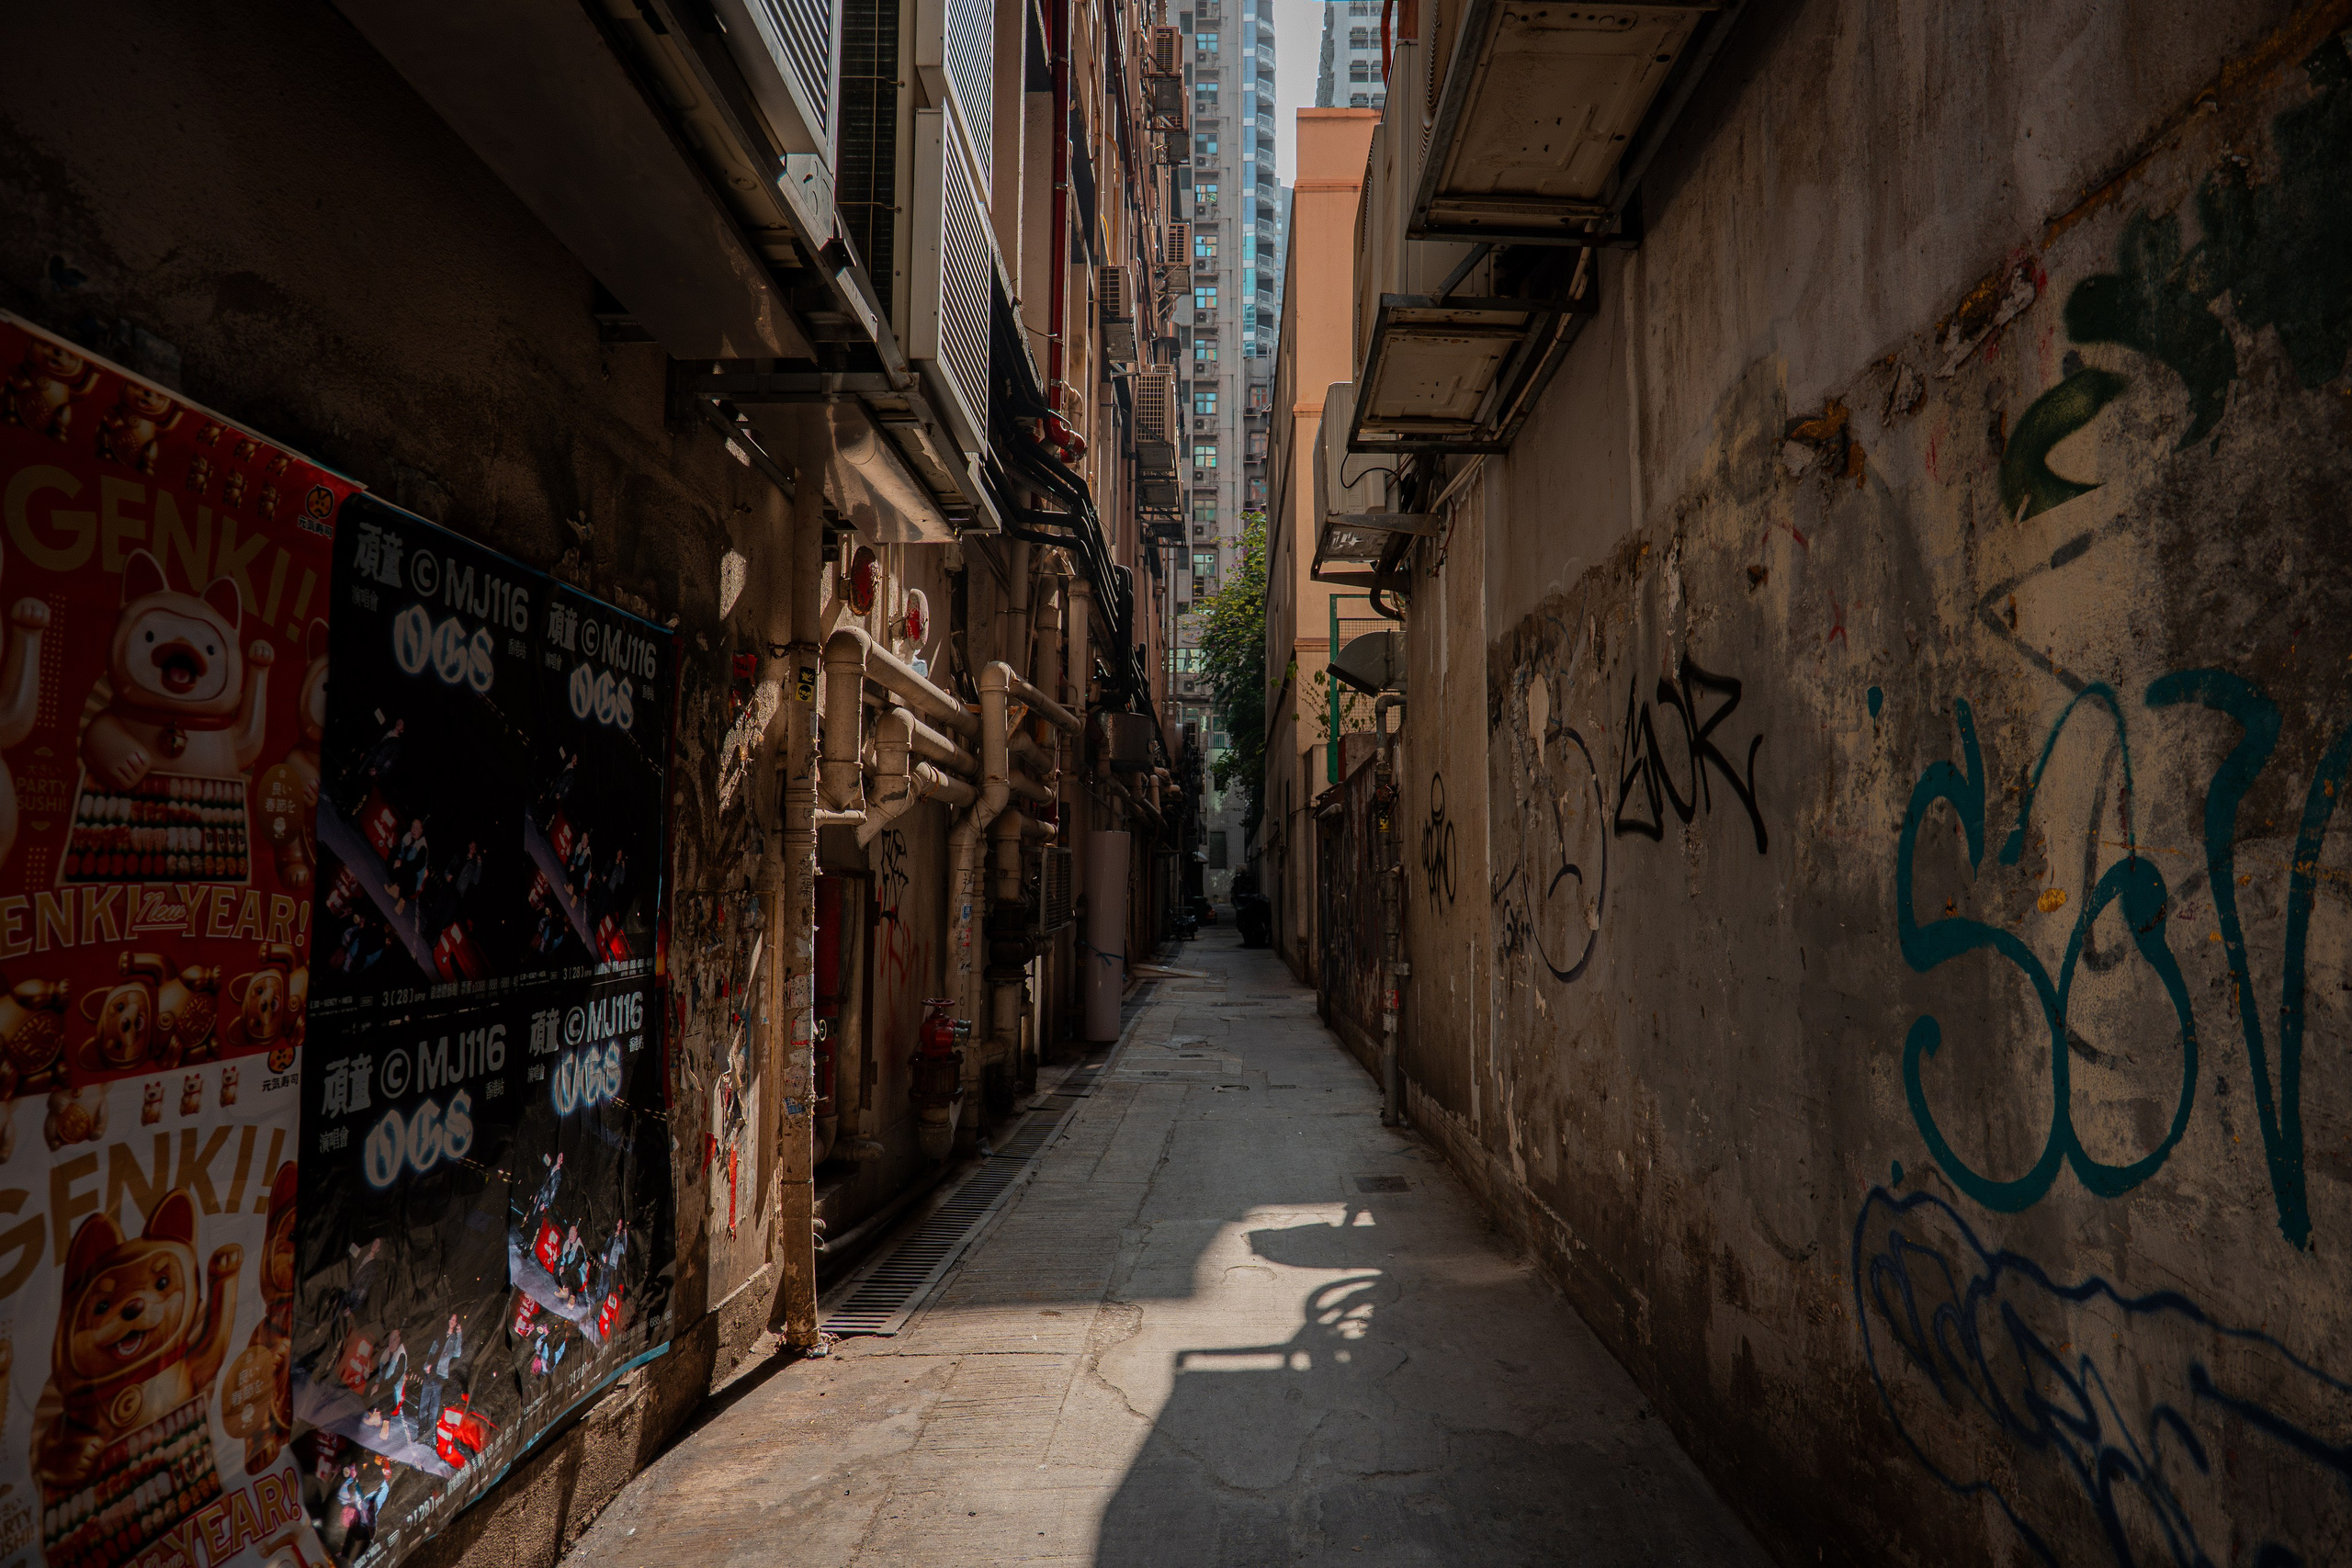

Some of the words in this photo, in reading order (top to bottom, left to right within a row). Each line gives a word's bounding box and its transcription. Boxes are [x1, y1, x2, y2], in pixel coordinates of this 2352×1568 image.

[351, 583, 379, 613] 演唱會
[353, 522, 404, 589] 頑童
[444, 558, 529, 634] MJ116
[391, 603, 495, 693] OGS
[547, 602, 579, 652] 頑童
[602, 624, 657, 680] MJ116
[570, 661, 634, 730] OGS
[16, 776, 68, 795] PARTY
[17, 795, 67, 813] SUSHI!
[135, 891, 187, 924] New
[175, 884, 311, 948] YEAR!
[529, 1007, 560, 1057] 頑童
[586, 991, 644, 1043] MJ116
[262, 1073, 299, 1092] 元気寿司
[321, 1052, 374, 1119] 頑童
[417, 1023, 507, 1094] MJ116
[485, 1077, 505, 1101] 香港站
[319, 1125, 350, 1154] 演唱會
[365, 1087, 474, 1188] OGS
[0, 1506, 32, 1540] RTY
